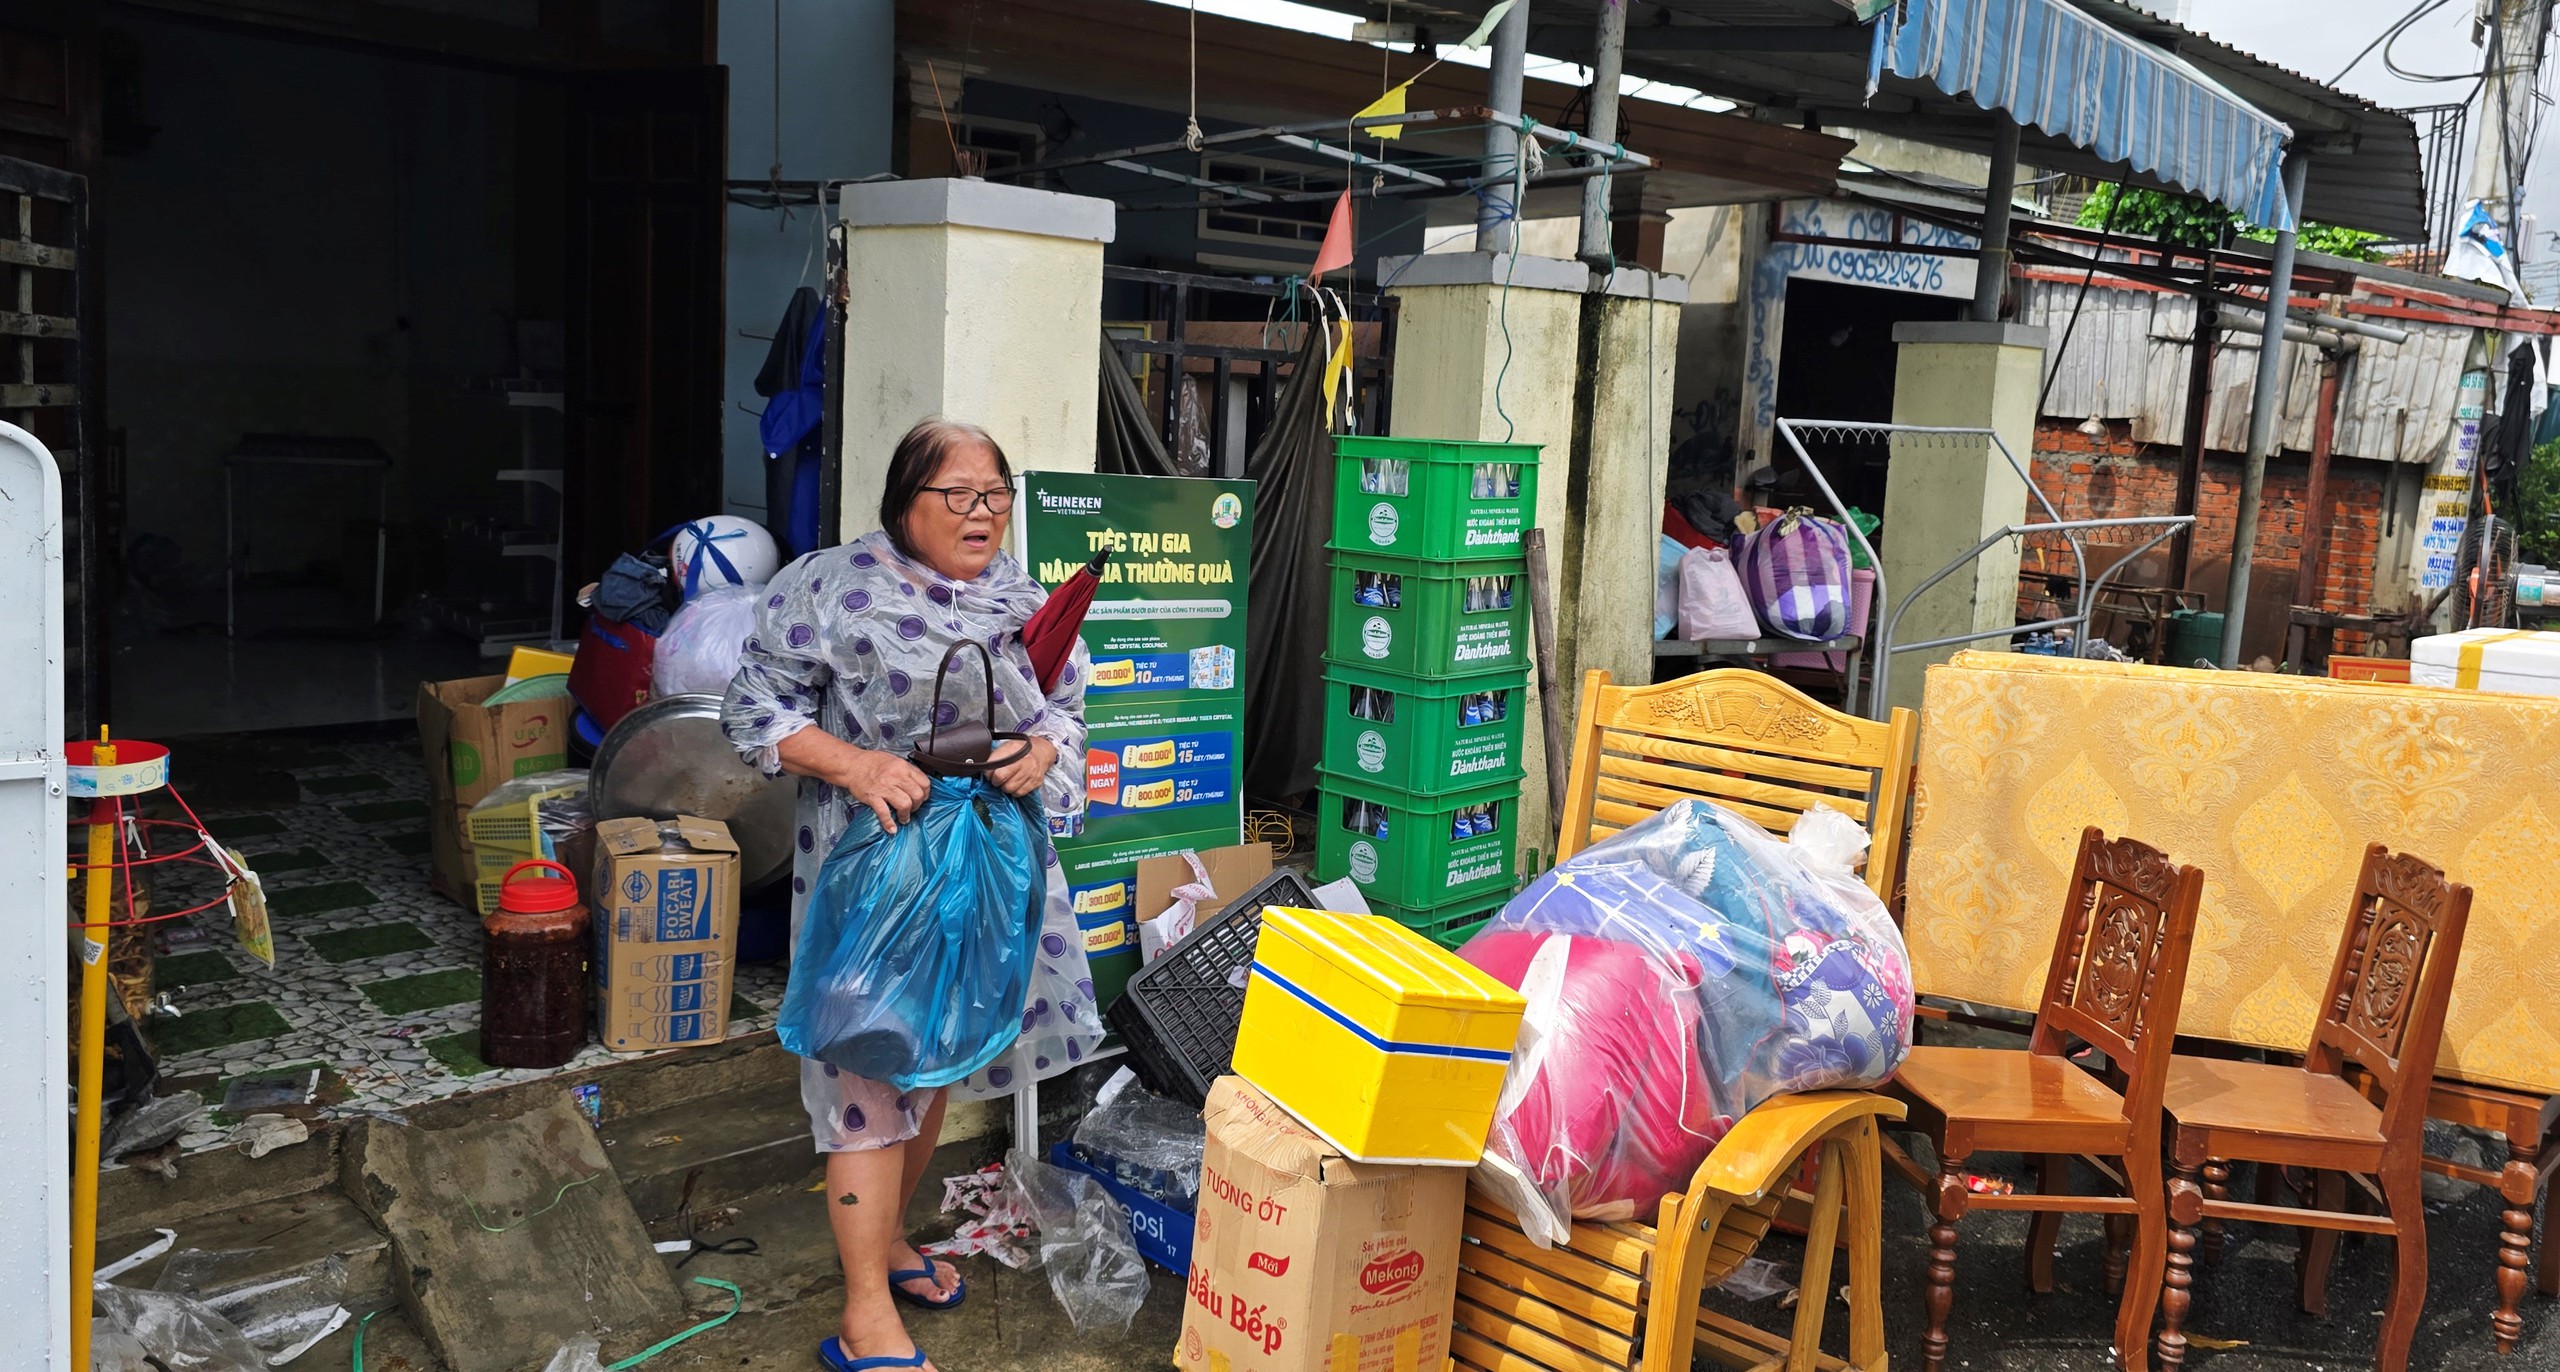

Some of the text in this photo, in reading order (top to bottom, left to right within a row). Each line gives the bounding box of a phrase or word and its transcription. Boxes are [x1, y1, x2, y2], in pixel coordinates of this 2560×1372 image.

[1042, 495, 1102, 508] HEINEKEN
[1086, 527, 1191, 557] TIỆC TẠI GIA
[1125, 557, 1195, 583] THƯỜNG
[1198, 559, 1233, 585] QUÀ
[1135, 671, 1152, 684] 10
[1178, 749, 1193, 763] 15
[1089, 763, 1117, 776] NHẬN
[1090, 777, 1116, 789] NGAY
[1176, 788, 1193, 802] 30
[666, 871, 680, 939] POCARI
[678, 877, 693, 939] SWEAT
[1205, 1166, 1253, 1214] TƯƠNG
[1258, 1196, 1287, 1226] ỚT
[1120, 1203, 1163, 1242] epsi
[1167, 1244, 1177, 1257] 17
[1257, 1255, 1279, 1274] Mới
[1365, 1260, 1419, 1286] Mekong
[1188, 1260, 1222, 1319] Đầu
[1229, 1293, 1283, 1356] Bếp
